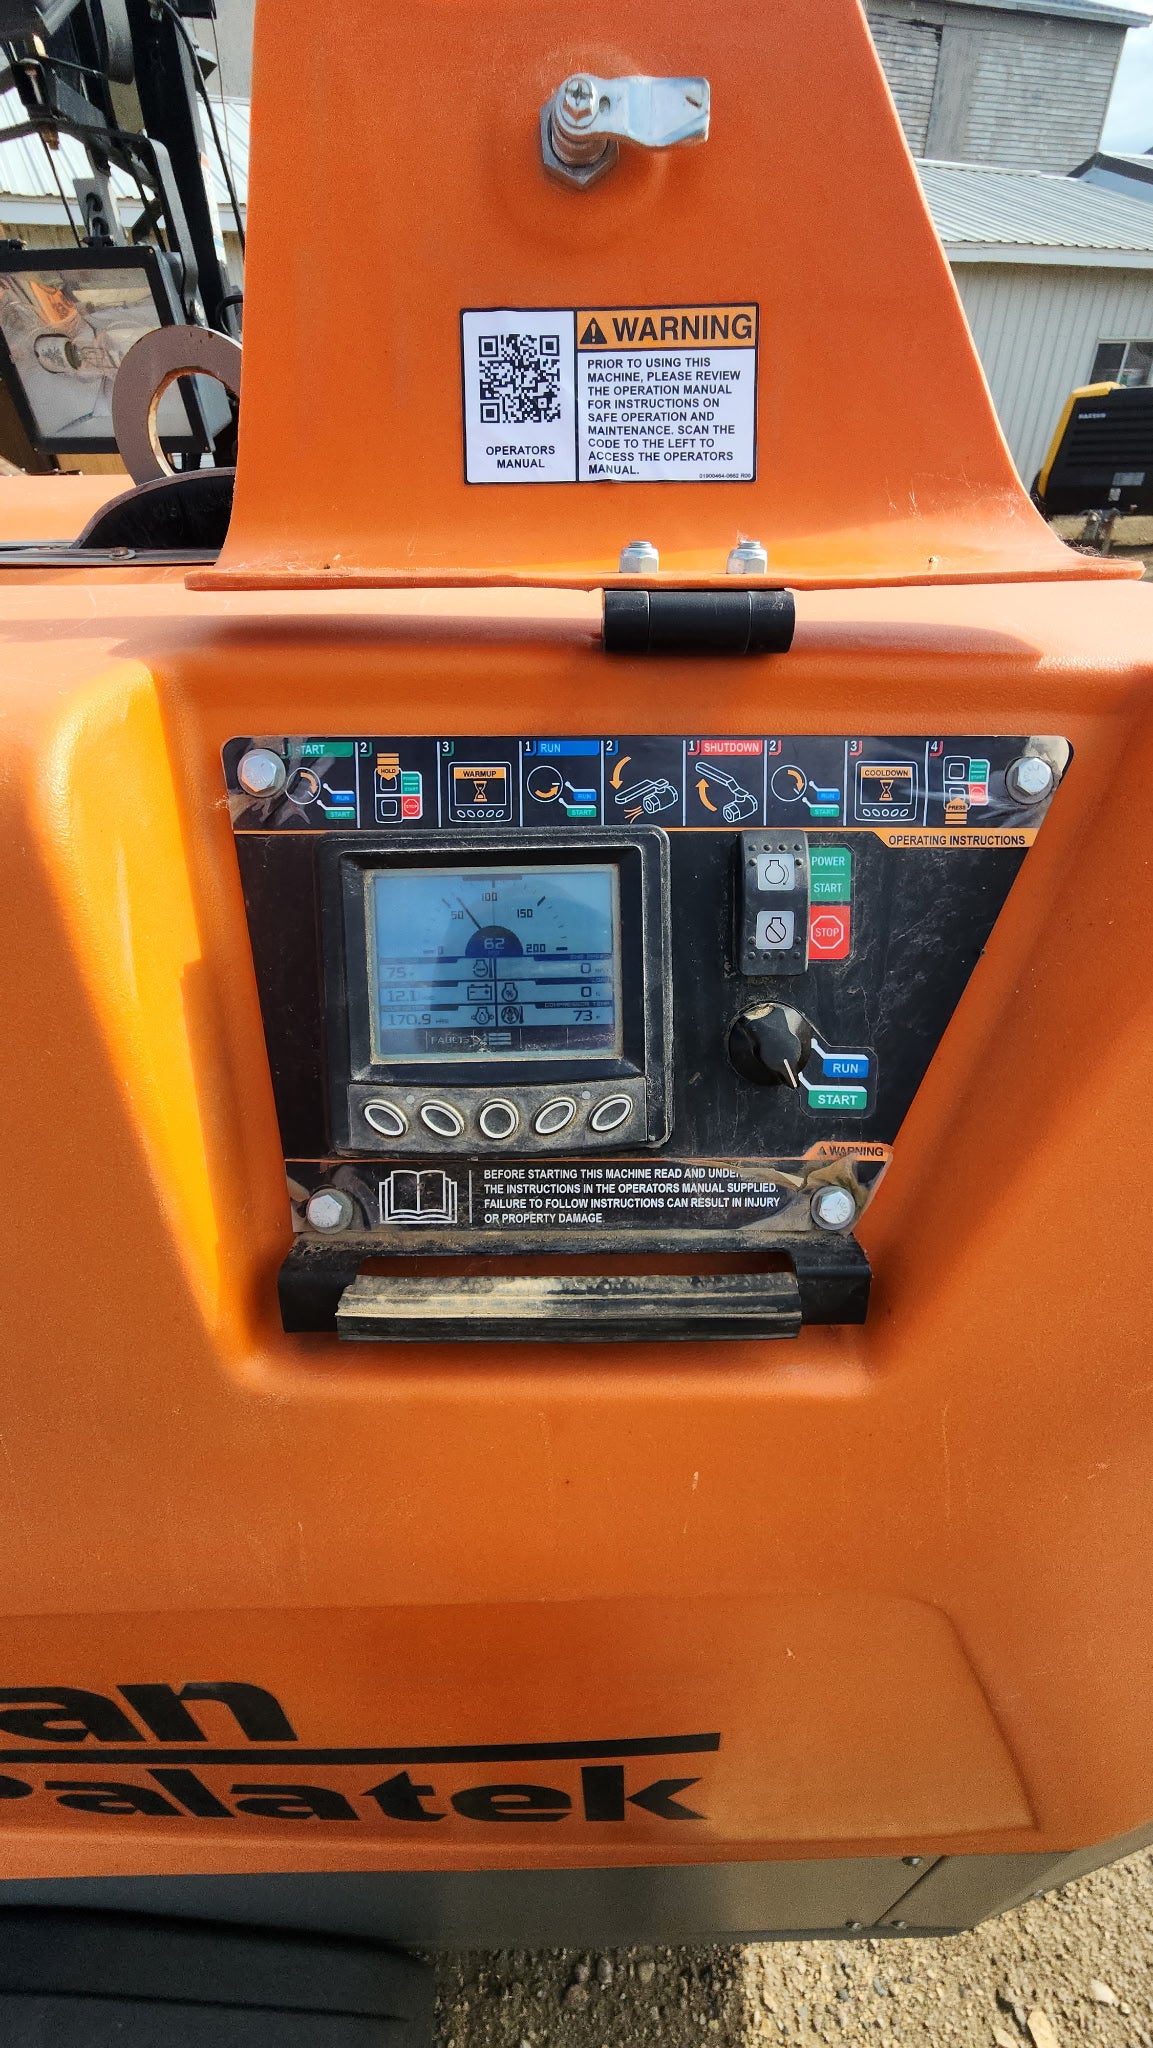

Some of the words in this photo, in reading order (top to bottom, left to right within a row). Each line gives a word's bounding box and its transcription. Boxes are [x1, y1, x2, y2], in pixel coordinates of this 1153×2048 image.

[612, 313, 752, 341] WARNING
[587, 359, 623, 369] PRIOR
[627, 358, 642, 368] TO
[646, 358, 681, 368] USING
[685, 357, 711, 367] THIS
[587, 372, 644, 383] MACHINE,
[647, 371, 692, 382] PLEASE
[696, 370, 740, 381] REVIEW
[588, 386, 610, 396] THE
[614, 385, 680, 396] OPERATION
[684, 384, 732, 394] MANUAL
[588, 400, 611, 409] FOR
[614, 398, 699, 409] INSTRUCTIONS
[703, 398, 720, 408] ON
[588, 413, 617, 422] SAFE
[621, 412, 686, 422] OPERATION
[690, 412, 714, 421] AND
[588, 426, 674, 436] MAINTENANCE.
[678, 425, 709, 434] SCAN
[713, 425, 735, 434] THE
[588, 439, 620, 448] CODE
[624, 439, 639, 448] TO
[642, 438, 664, 448] THE
[668, 438, 696, 448] LEFT
[700, 438, 715, 447] TO
[485, 445, 556, 456] OPERATORS
[588, 452, 634, 462] ACCESS
[639, 452, 660, 461] THE
[663, 452, 734, 461] OPERATORS
[496, 459, 545, 469] MANUAL
[588, 464, 640, 474] MANUAL.
[360, 742, 368, 752] 2
[442, 742, 449, 752] 3
[525, 742, 531, 751] 1
[541, 744, 560, 753] RUN
[606, 741, 613, 751] 2
[689, 741, 695, 750] 1
[704, 743, 759, 753] SHUTDOWN
[769, 741, 776, 751] 2
[850, 741, 857, 751] 3
[930, 741, 938, 752] 4
[889, 835, 946, 845] OPERATING
[950, 835, 1025, 845] INSTRUCTIONS
[811, 856, 845, 866] POWER
[813, 883, 842, 893] START
[482, 892, 497, 902] 100
[451, 911, 464, 920] 50
[517, 909, 533, 918] 150
[815, 928, 840, 937] STOP
[484, 938, 505, 949] 62
[526, 944, 546, 953] 200
[386, 967, 406, 978] 75
[580, 963, 591, 974] 0
[581, 987, 591, 997] 0
[388, 1014, 431, 1025] 170.9
[573, 1010, 593, 1021] 73
[833, 1063, 859, 1073] RUN
[817, 1095, 858, 1105] START
[830, 1146, 883, 1157] WARNING
[484, 1169, 525, 1179] BEFORE
[528, 1169, 578, 1179] STARTING
[581, 1169, 603, 1179] THIS
[606, 1169, 651, 1179] MACHINE
[654, 1169, 682, 1178] READ
[684, 1168, 706, 1178] AND
[484, 1184, 504, 1194] THE
[507, 1184, 580, 1194] INSTRUCTIONS
[583, 1184, 593, 1193] IN
[596, 1184, 615, 1193] THE
[618, 1183, 680, 1193] OPERATORS
[682, 1183, 724, 1193] MANUAL
[727, 1183, 779, 1193] SUPPLIED.
[484, 1199, 526, 1208] FAILURE
[529, 1199, 542, 1208] TO
[545, 1199, 588, 1208] FOLLOW
[591, 1198, 664, 1208] INSTRUCTIONS
[667, 1198, 688, 1208] CAN
[691, 1198, 729, 1208] RESULT
[732, 1198, 741, 1208] IN
[744, 1197, 780, 1207] INJURY
[484, 1214, 500, 1223] OR
[502, 1213, 556, 1223] PROPERTY
[0, 1765, 708, 1822] alatek
